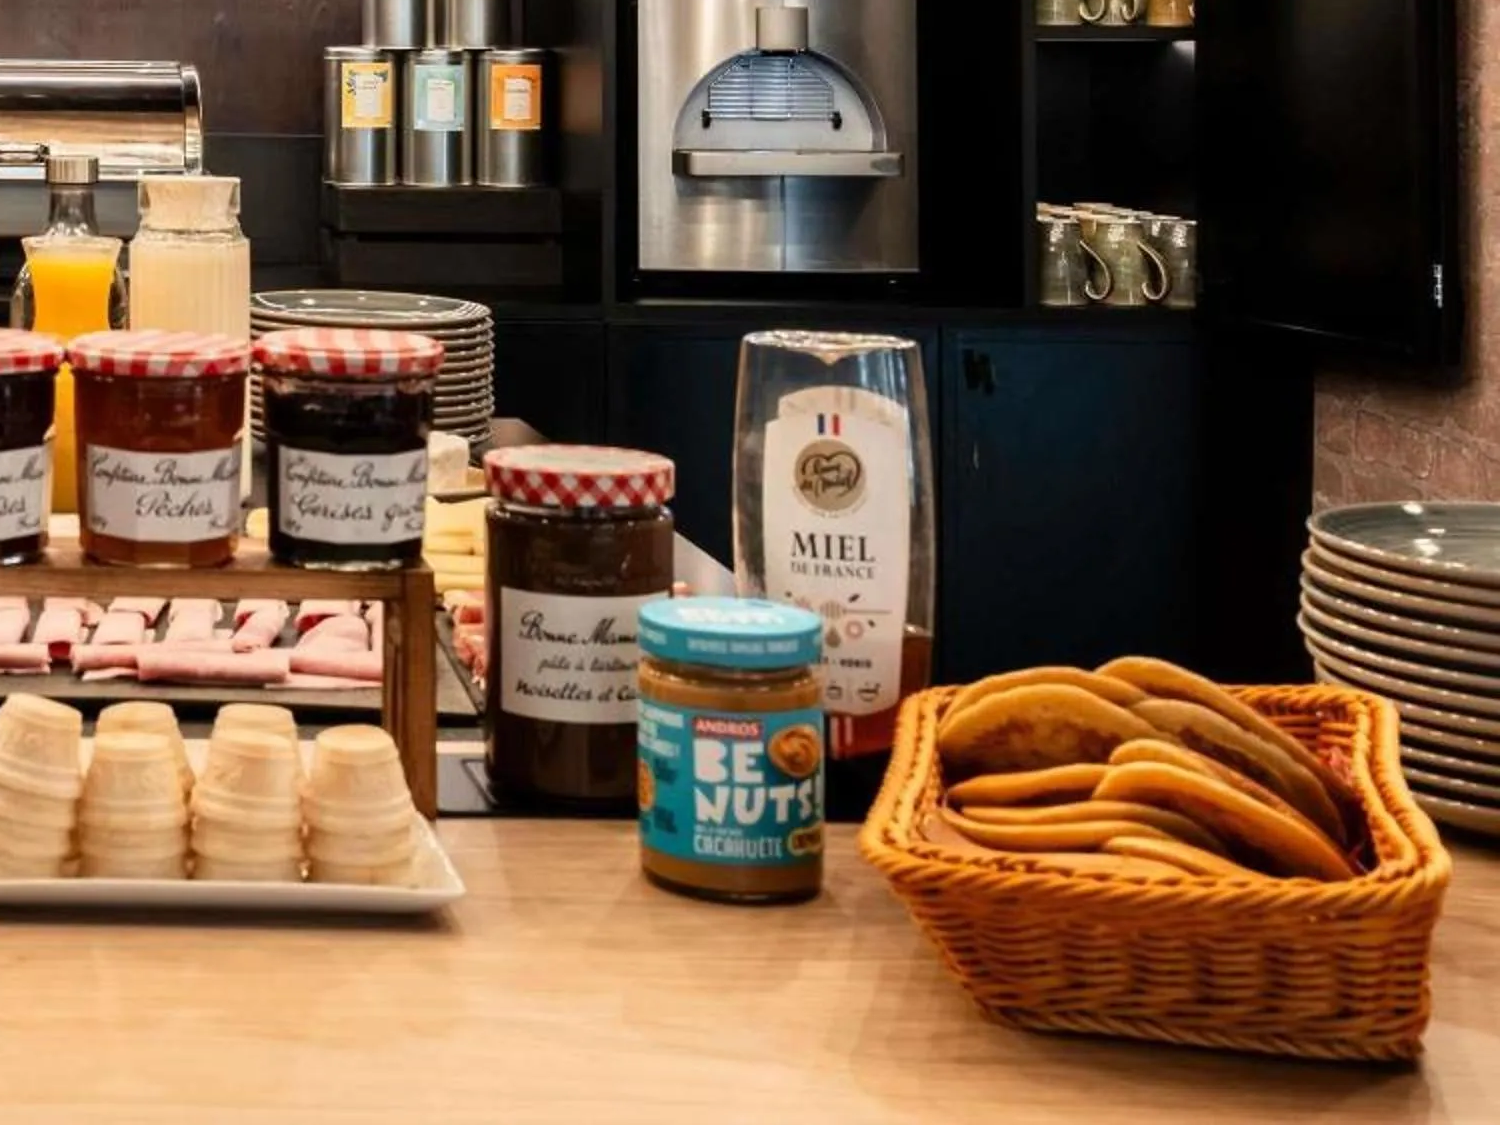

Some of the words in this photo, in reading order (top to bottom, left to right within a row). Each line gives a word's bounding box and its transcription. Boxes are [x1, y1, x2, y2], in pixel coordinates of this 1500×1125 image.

[135, 489, 214, 518] Pêches
[790, 530, 877, 563] MIEL
[790, 561, 809, 575] DE
[813, 562, 876, 581] FRANCE
[518, 609, 578, 643] Bonne
[597, 684, 614, 703] et
[694, 718, 762, 738] ANDROS
[694, 738, 766, 784] BE
